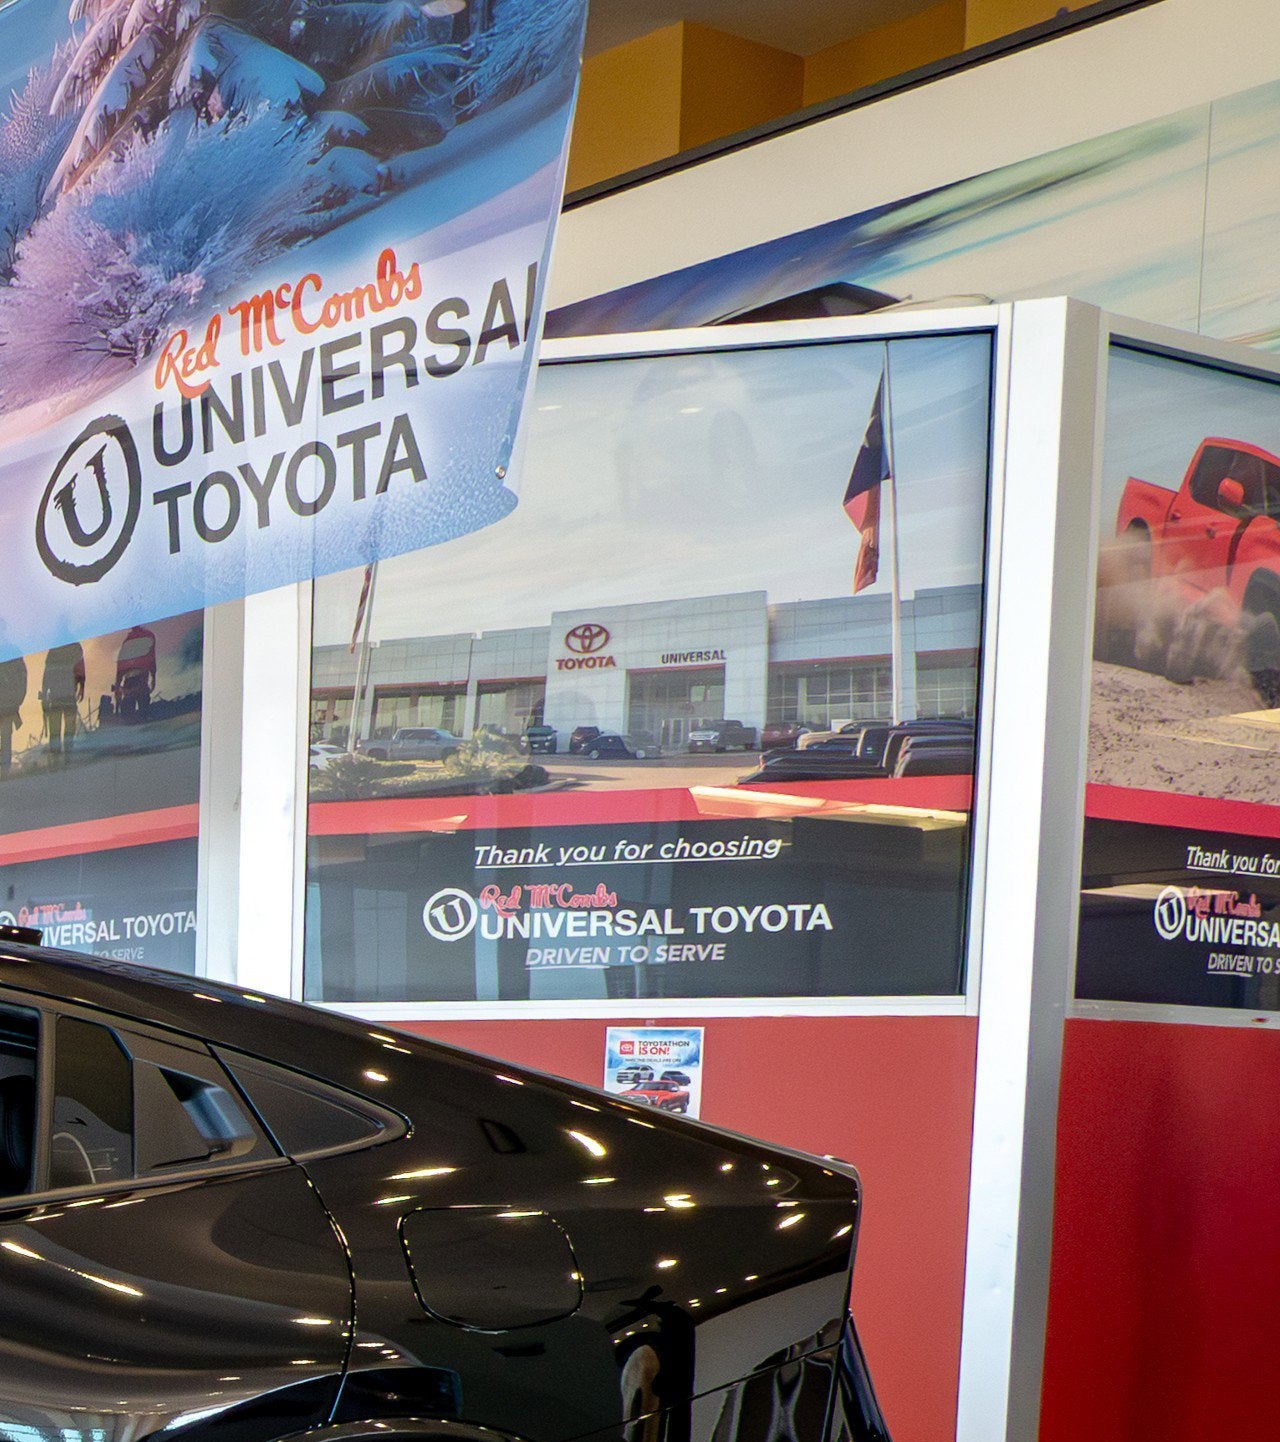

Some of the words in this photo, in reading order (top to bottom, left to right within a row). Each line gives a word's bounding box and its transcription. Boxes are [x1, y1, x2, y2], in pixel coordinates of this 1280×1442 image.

[155, 313, 221, 399] Red
[229, 248, 423, 356] McCombs
[153, 413, 427, 554] TOYOTA
[556, 655, 617, 670] TOYOTA
[661, 649, 727, 664] UNIVERSAL
[474, 843, 551, 865] Thank
[556, 845, 607, 867] you
[613, 840, 652, 861] for
[659, 836, 783, 860] choosing
[1187, 846, 1229, 868] Thank
[1232, 854, 1258, 873] you
[1261, 854, 1280, 874] for
[479, 884, 522, 918] Red
[524, 882, 617, 908] McCombs
[40, 919, 120, 946] IVERSAL
[123, 911, 197, 939] TOYOTA
[480, 908, 684, 940] UNIVERSAL
[689, 903, 834, 934] TOYOTA
[526, 945, 611, 965] DRIVEN
[617, 945, 650, 963] TO
[654, 943, 727, 963] SERVE
[1208, 952, 1254, 972] DRIVEN
[1257, 957, 1273, 974] TO
[638, 1047, 648, 1055] IS
[649, 1047, 670, 1056] ON!
